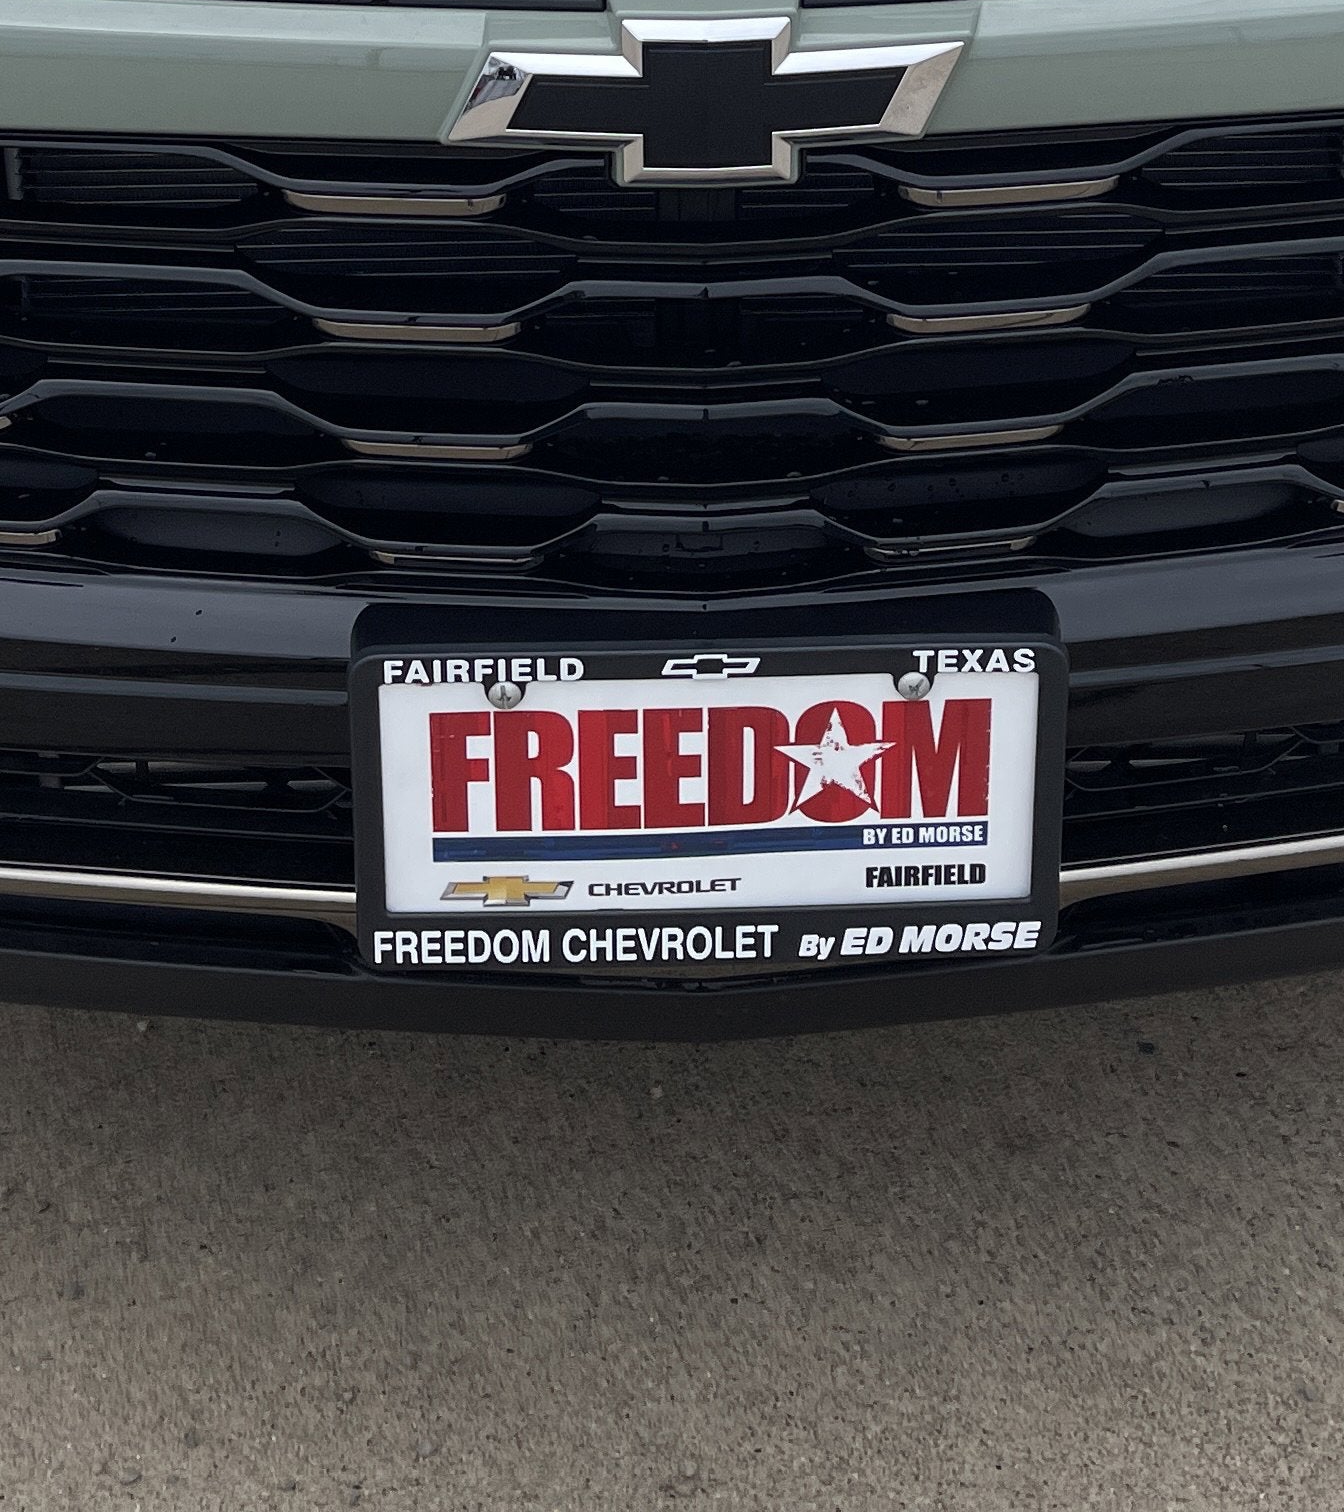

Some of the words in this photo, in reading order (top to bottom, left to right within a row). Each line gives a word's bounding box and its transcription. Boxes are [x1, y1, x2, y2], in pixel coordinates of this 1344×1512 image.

[383, 657, 585, 685] FAIRFIELD
[912, 648, 1037, 674] TEXAS
[429, 699, 992, 832] FREEDOM
[862, 827, 888, 845] BY
[891, 826, 914, 844] ED
[918, 824, 985, 844] MORSE
[587, 877, 743, 897] CHEVROLET
[865, 863, 987, 888] FAIRFIELD
[373, 928, 551, 965] FREEDOM
[561, 923, 780, 964] CHEVROLET
[798, 933, 836, 961] By
[839, 926, 894, 956] ED
[898, 920, 1042, 954] MORSE
